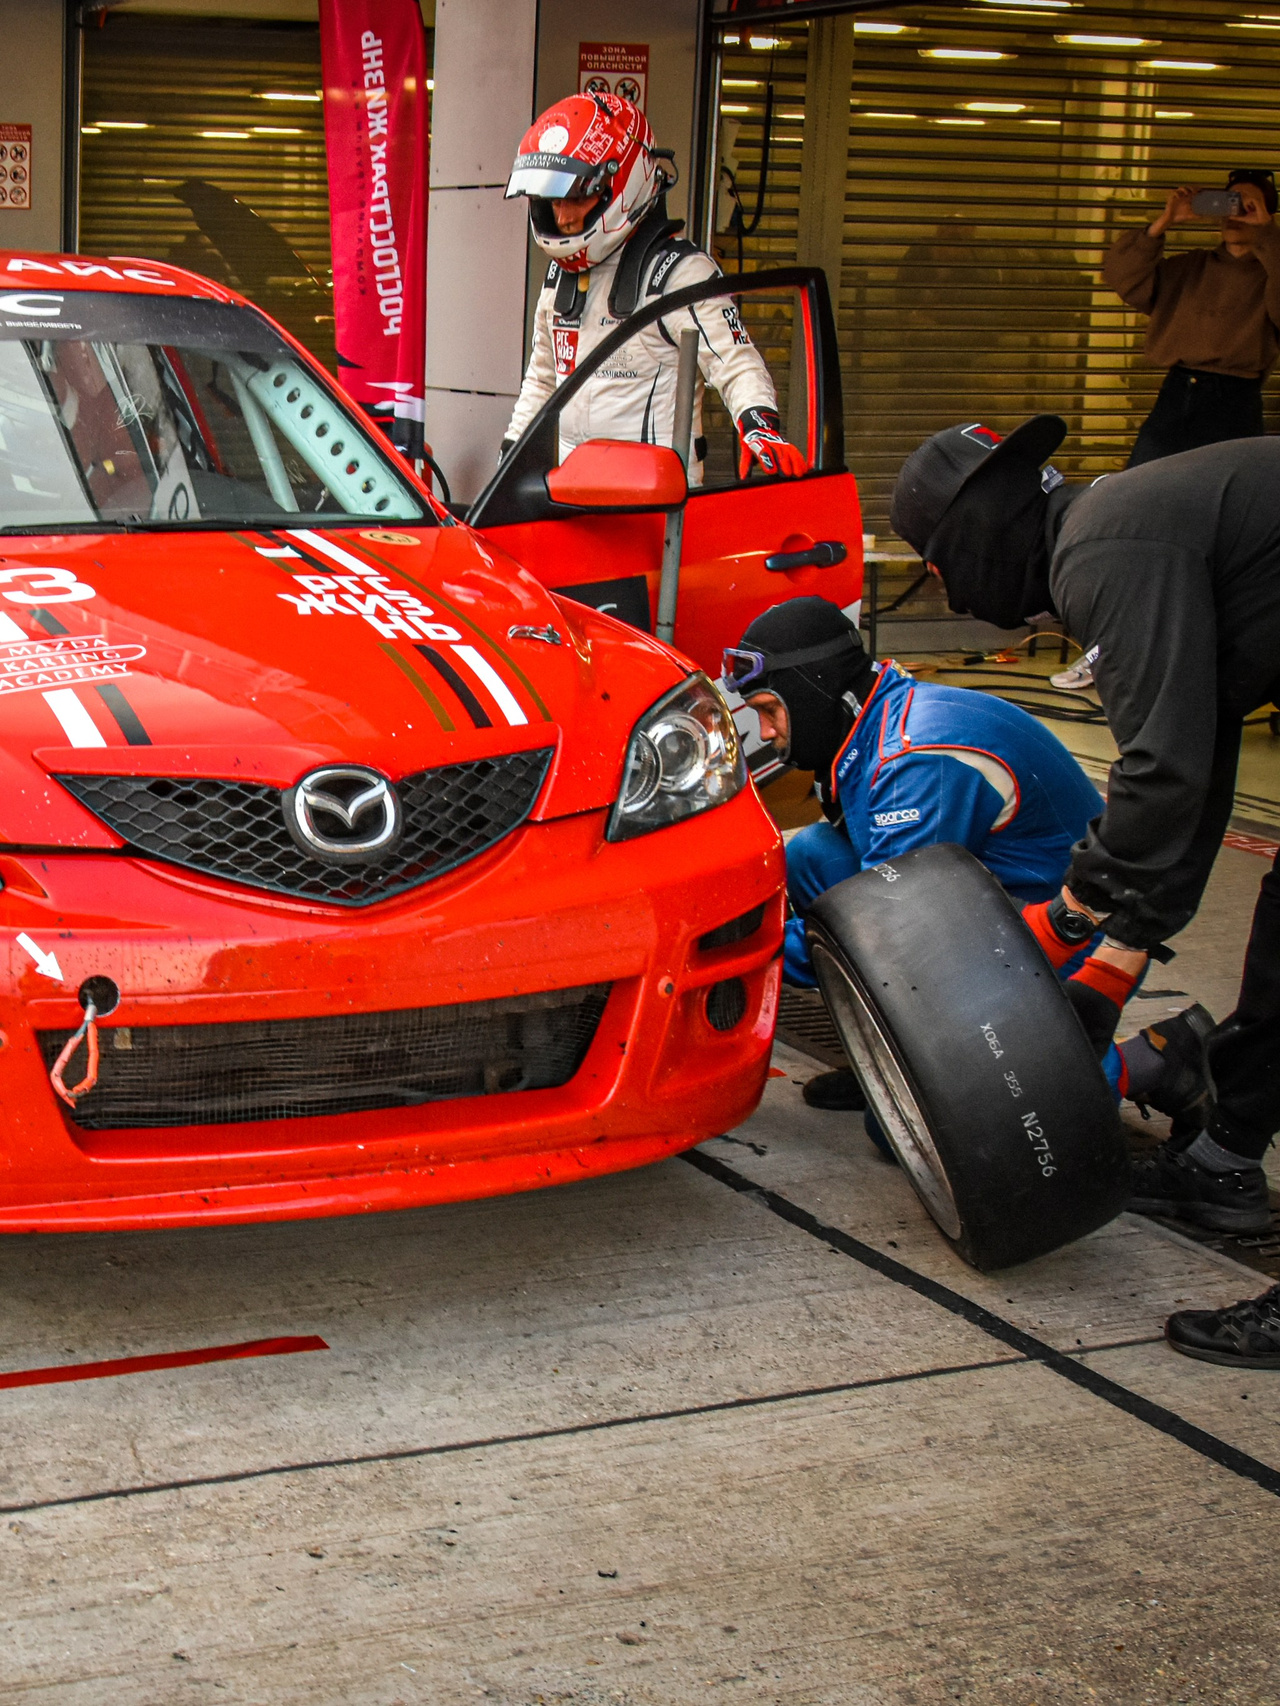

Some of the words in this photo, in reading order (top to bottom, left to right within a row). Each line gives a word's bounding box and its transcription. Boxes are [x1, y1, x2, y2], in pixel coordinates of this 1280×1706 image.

[580, 53, 647, 63] ПОВЫШЕННОЙ
[602, 46, 626, 54] ЗОНА
[586, 62, 643, 70] ОПАСНОСТИ
[652, 251, 680, 287] sparco
[6, 320, 83, 331] ВЫНОСЛИВОСТЬ
[601, 370, 639, 378] SMIRNOV
[292, 574, 411, 596] РГС
[276, 593, 435, 616] ЖИЗ
[362, 614, 463, 641] НЬ
[8, 638, 109, 658] MAZDA
[3, 651, 122, 673] KARTING
[874, 808, 920, 827] sparco
[980, 1022, 1005, 1060] X06A
[1003, 1070, 1024, 1098] 355
[1021, 1111, 1058, 1178] N2756
